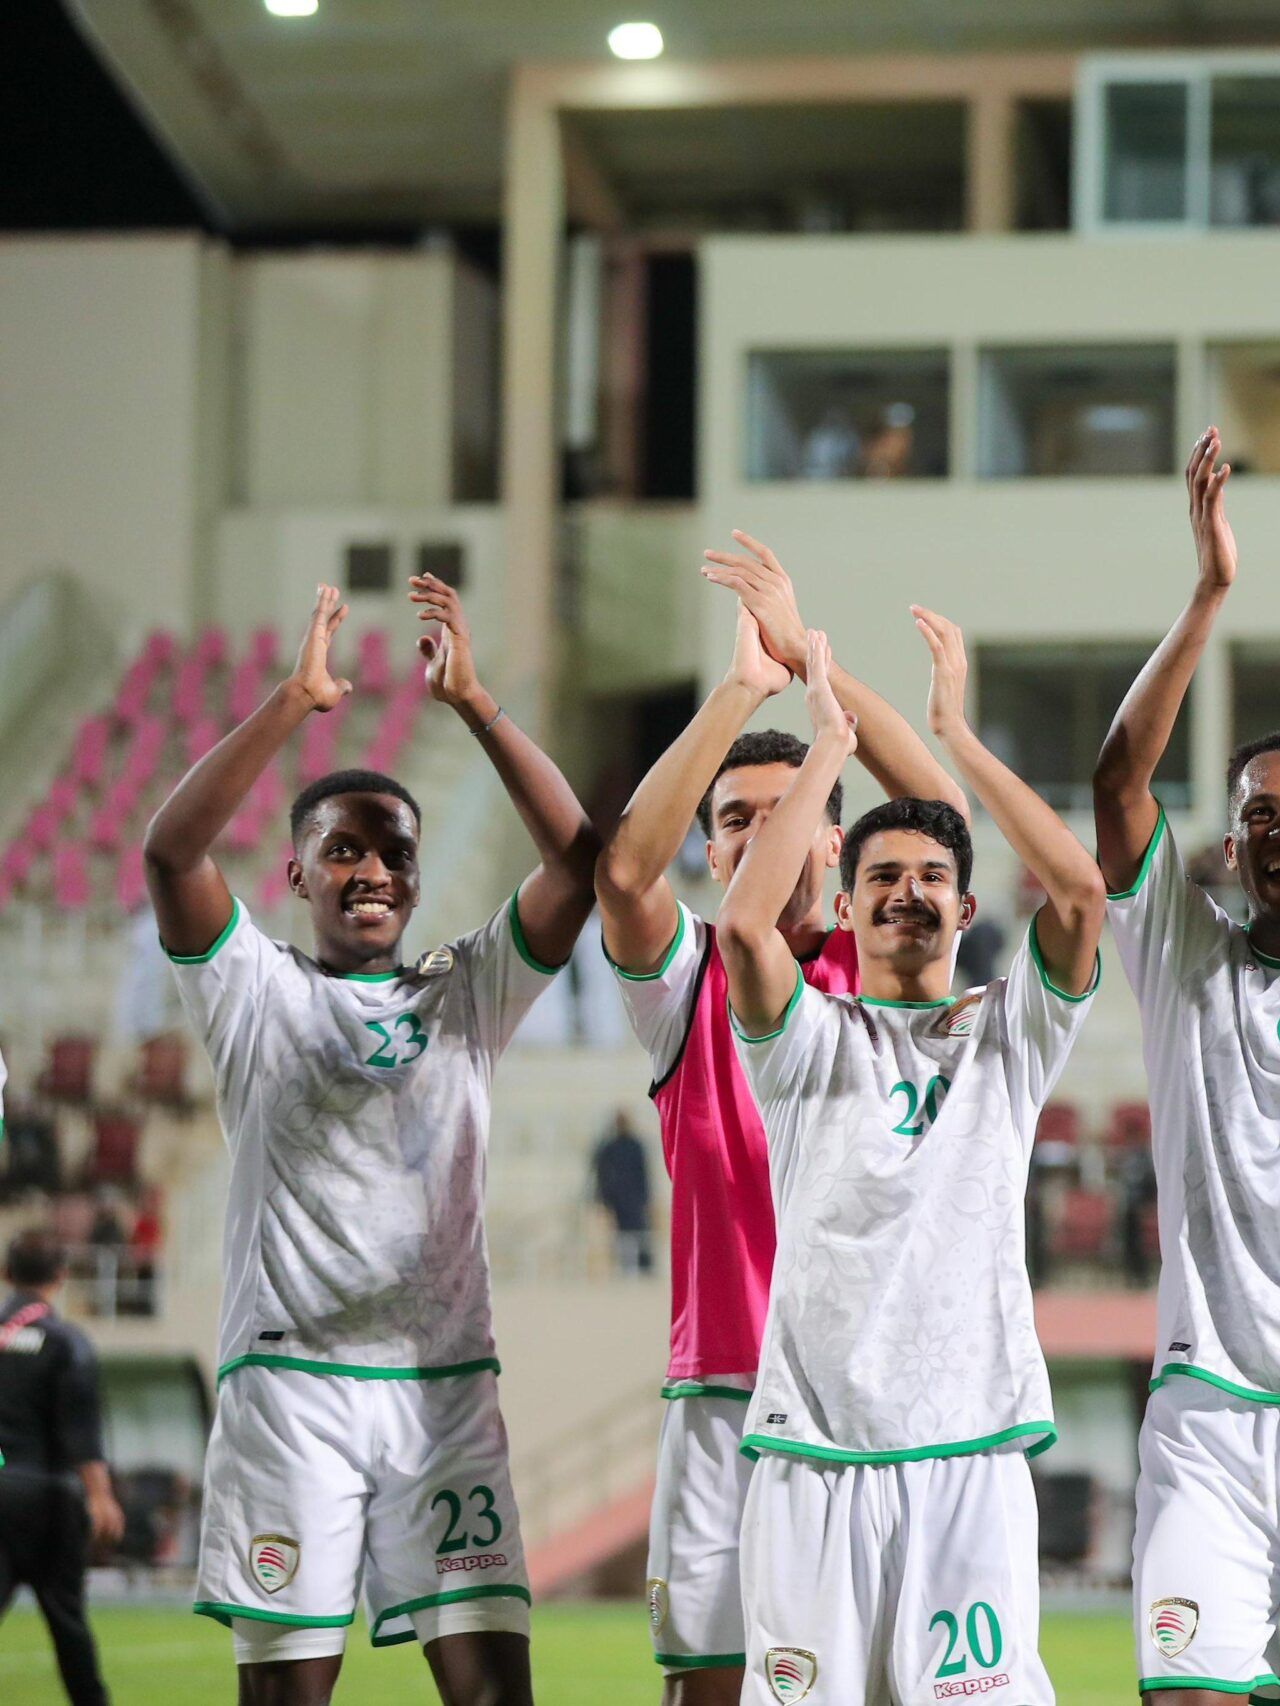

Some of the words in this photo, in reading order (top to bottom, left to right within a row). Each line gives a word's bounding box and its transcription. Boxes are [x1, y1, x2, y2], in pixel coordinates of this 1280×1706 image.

[364, 1012, 429, 1069] 23
[430, 1485, 502, 1554] 23
[436, 1553, 508, 1575] Kappa
[928, 1601, 1003, 1678] 20
[933, 1673, 1010, 1700] Kappa
